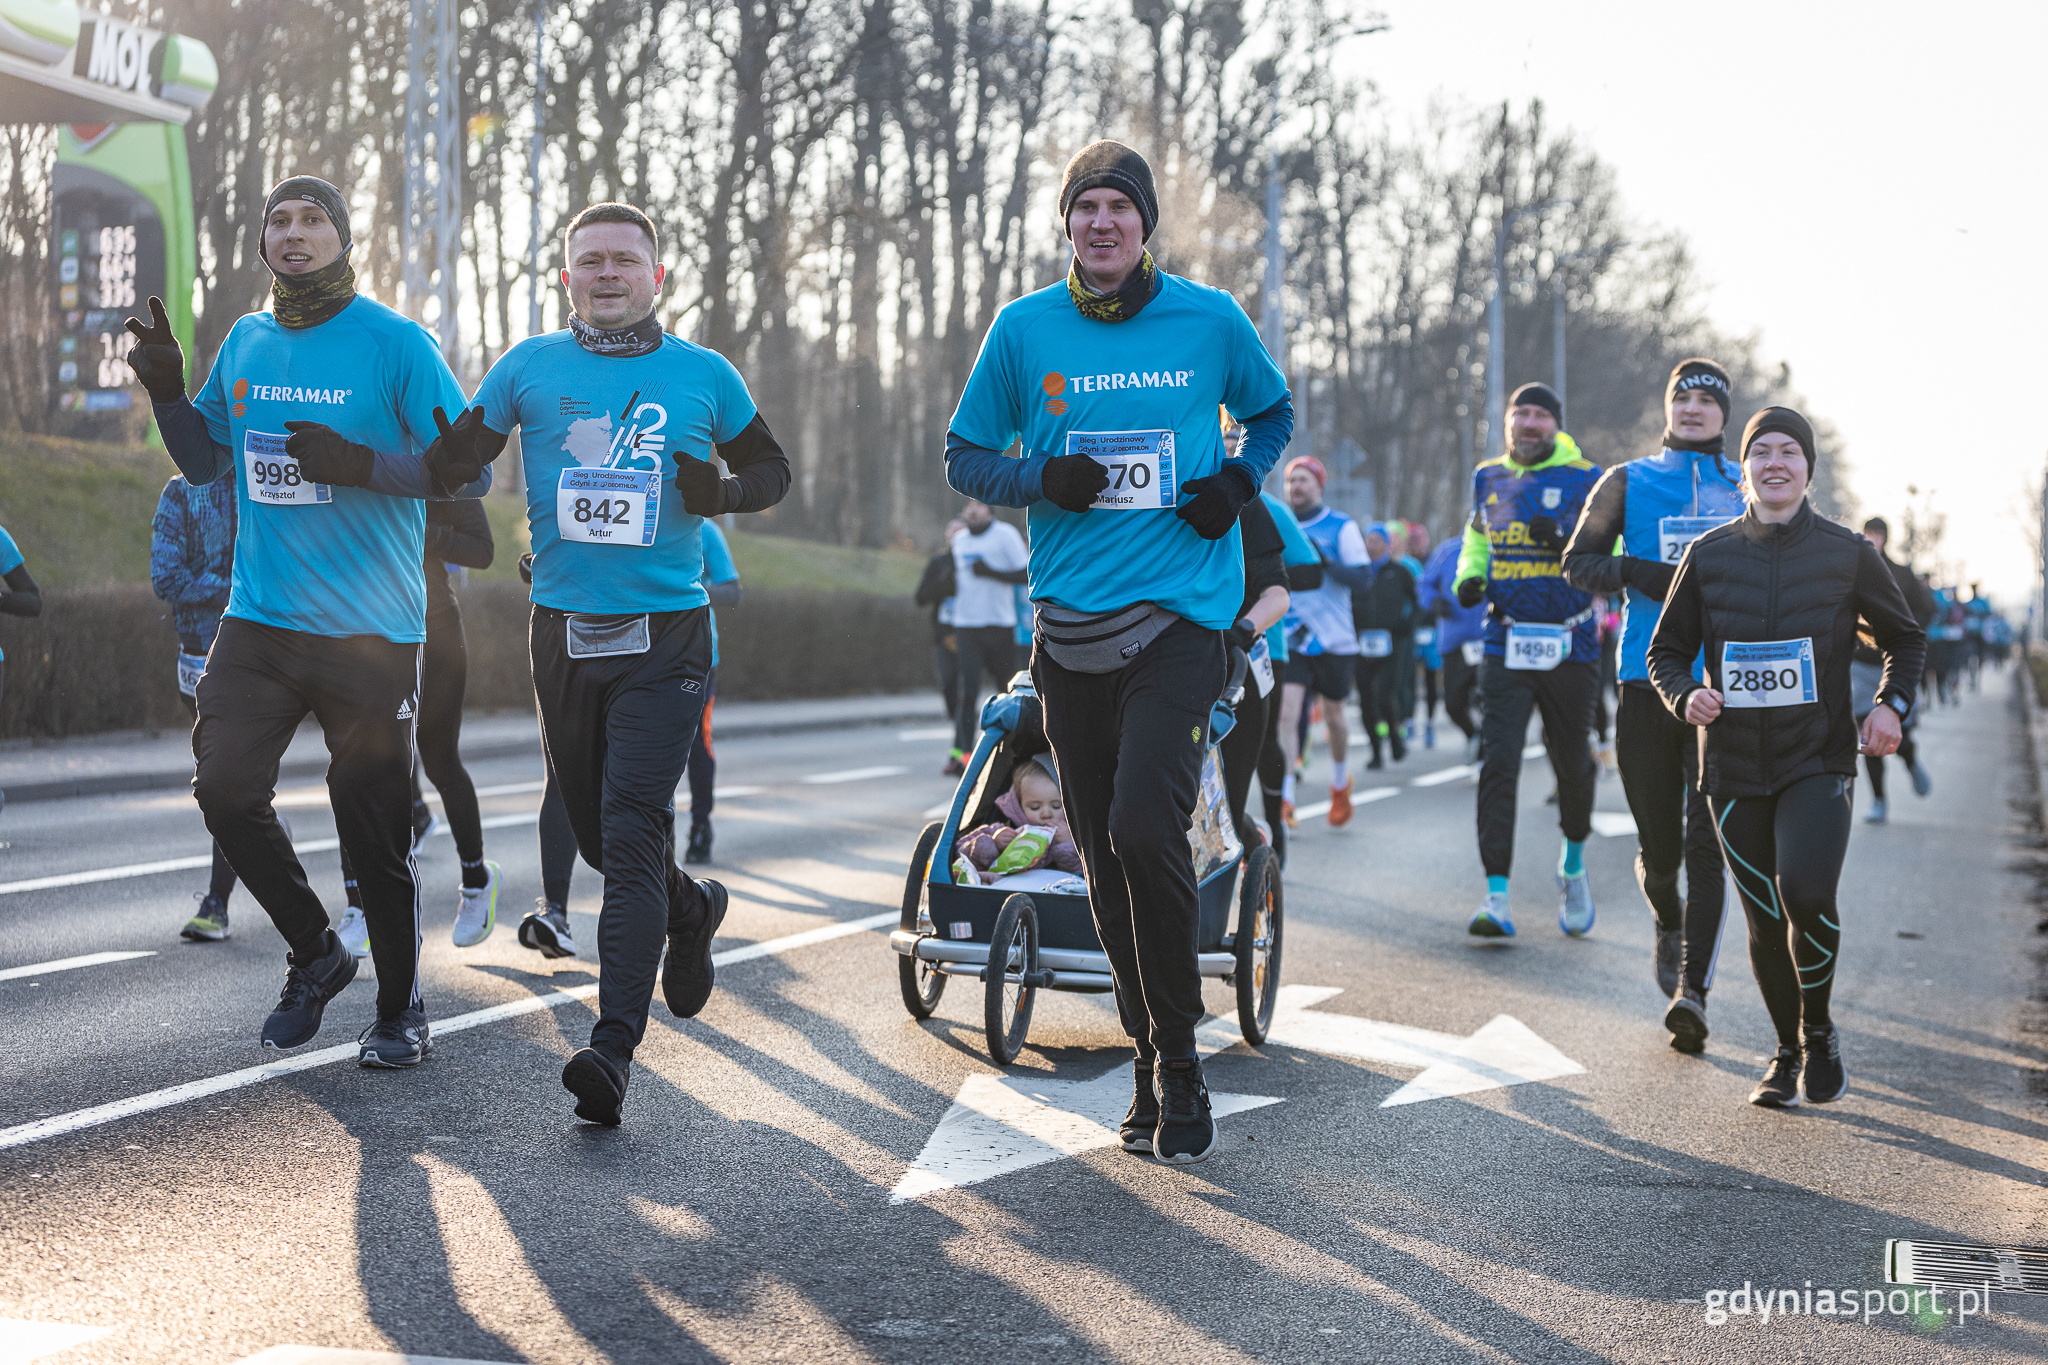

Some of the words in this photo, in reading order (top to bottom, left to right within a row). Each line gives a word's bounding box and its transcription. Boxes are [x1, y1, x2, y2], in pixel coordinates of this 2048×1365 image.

[87, 19, 152, 93] MOL
[252, 435, 263, 444] Bieg
[263, 437, 287, 445] Urodzin
[1079, 436, 1097, 445] Bieg
[1100, 435, 1146, 444] Urodzinowy
[1077, 445, 1099, 453] Gdyni
[1118, 444, 1149, 452] DECATHLON
[572, 471, 589, 480] Bieg
[591, 471, 636, 482] Urodzinowy
[1104, 462, 1151, 490] 70
[569, 479, 591, 488] Gdyni
[607, 481, 638, 489] DECATHLON
[260, 489, 296, 500] Krzysztof
[1096, 494, 1134, 504] Mariusz
[573, 497, 631, 525] 842
[588, 528, 613, 538] Artur
[1515, 641, 1557, 659] 1498
[1728, 668, 1798, 692] 2880
